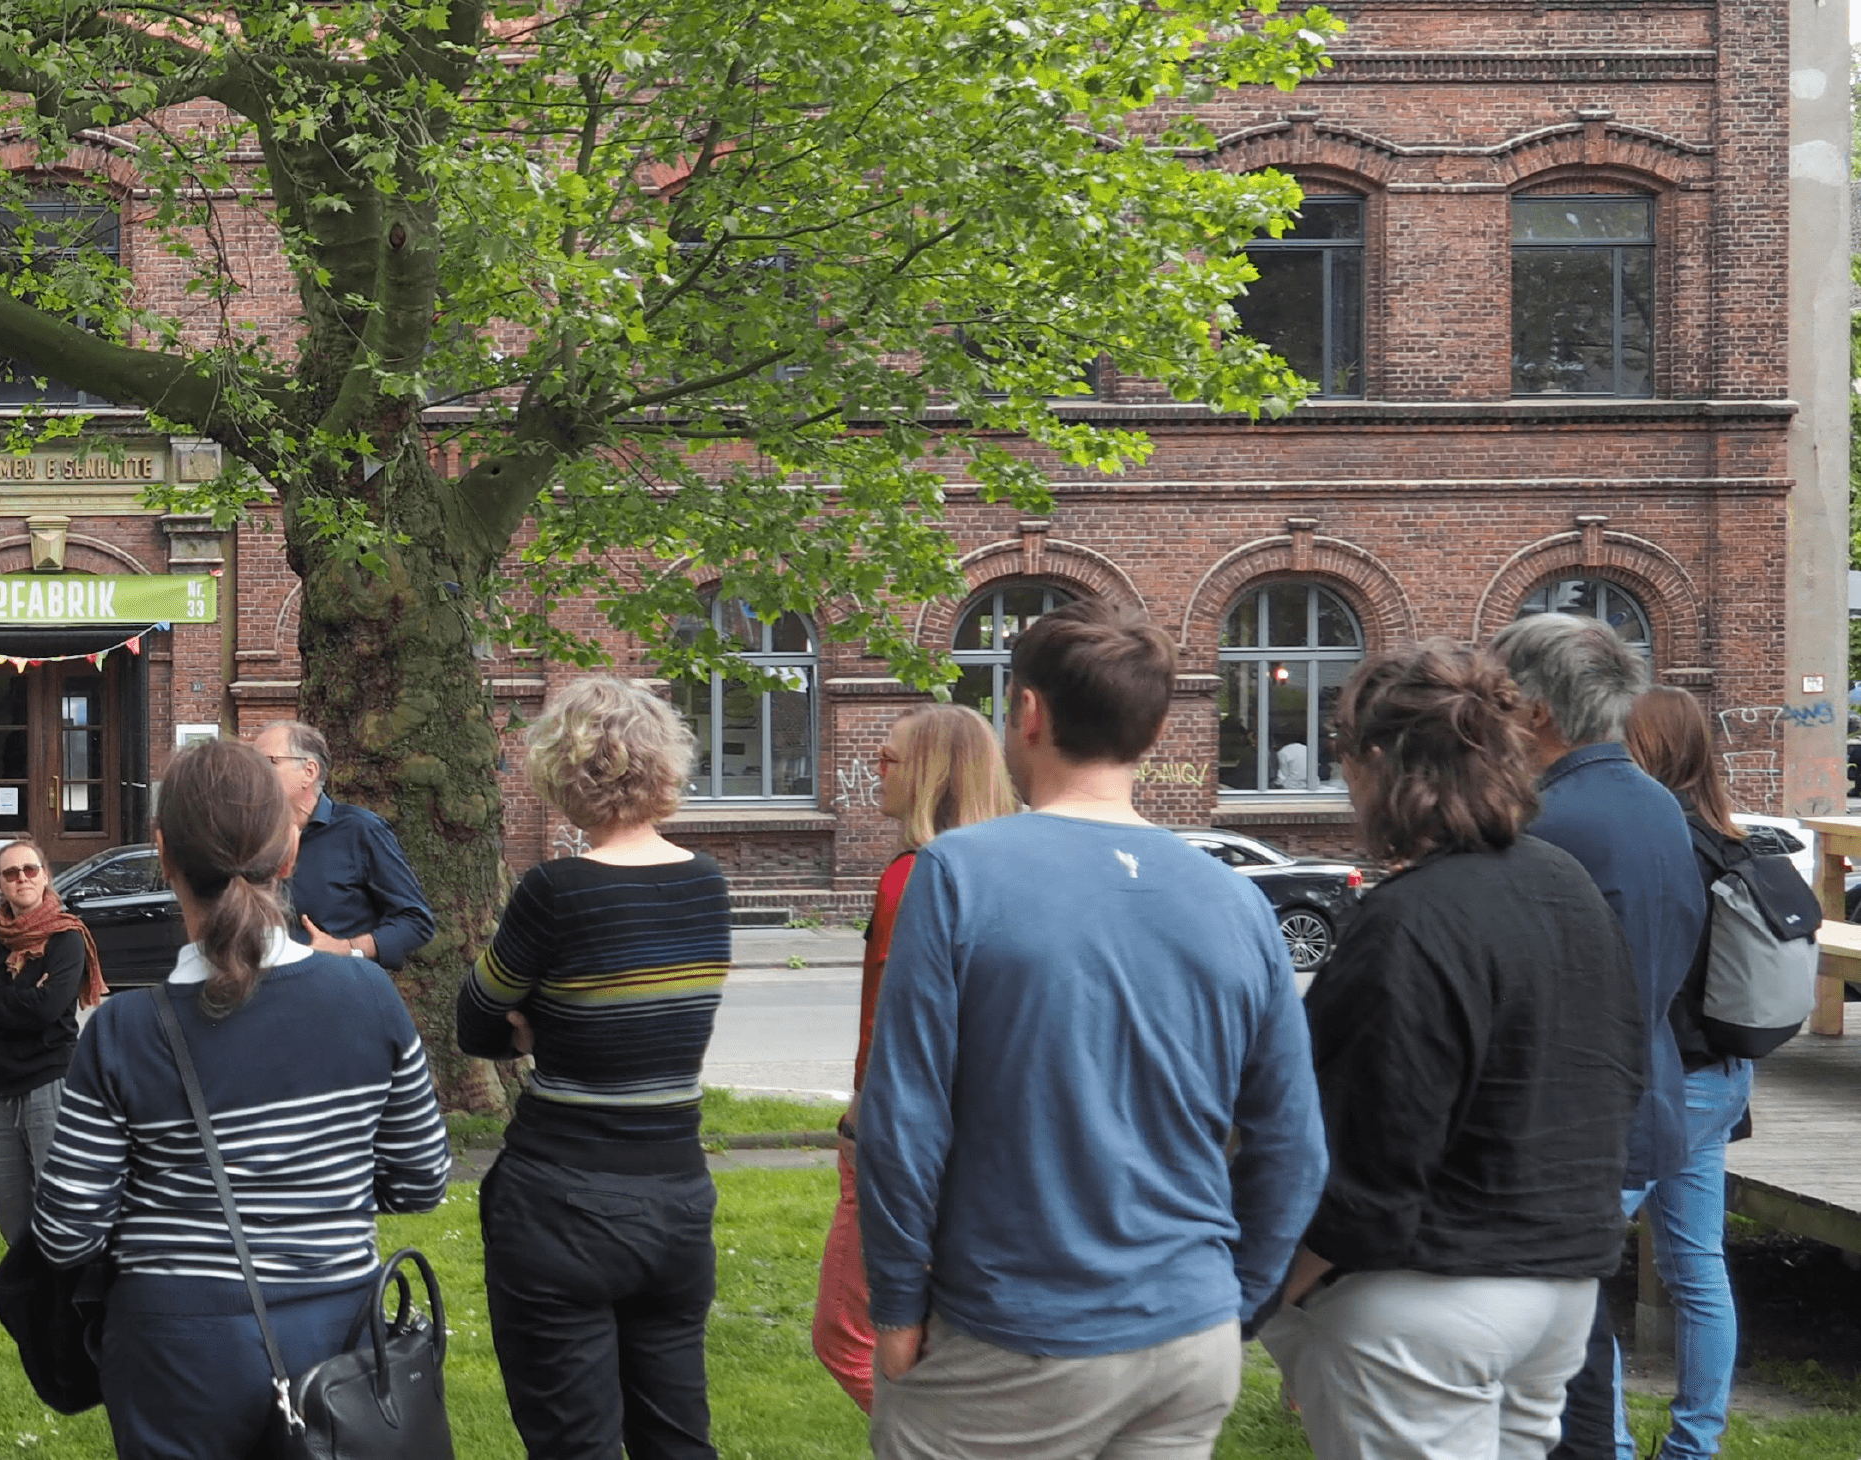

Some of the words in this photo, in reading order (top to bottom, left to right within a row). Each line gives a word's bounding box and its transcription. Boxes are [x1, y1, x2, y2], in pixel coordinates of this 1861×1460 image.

[46, 457, 153, 480] ESENHTTE
[187, 581, 205, 597] Nr.
[187, 600, 205, 617] 33
